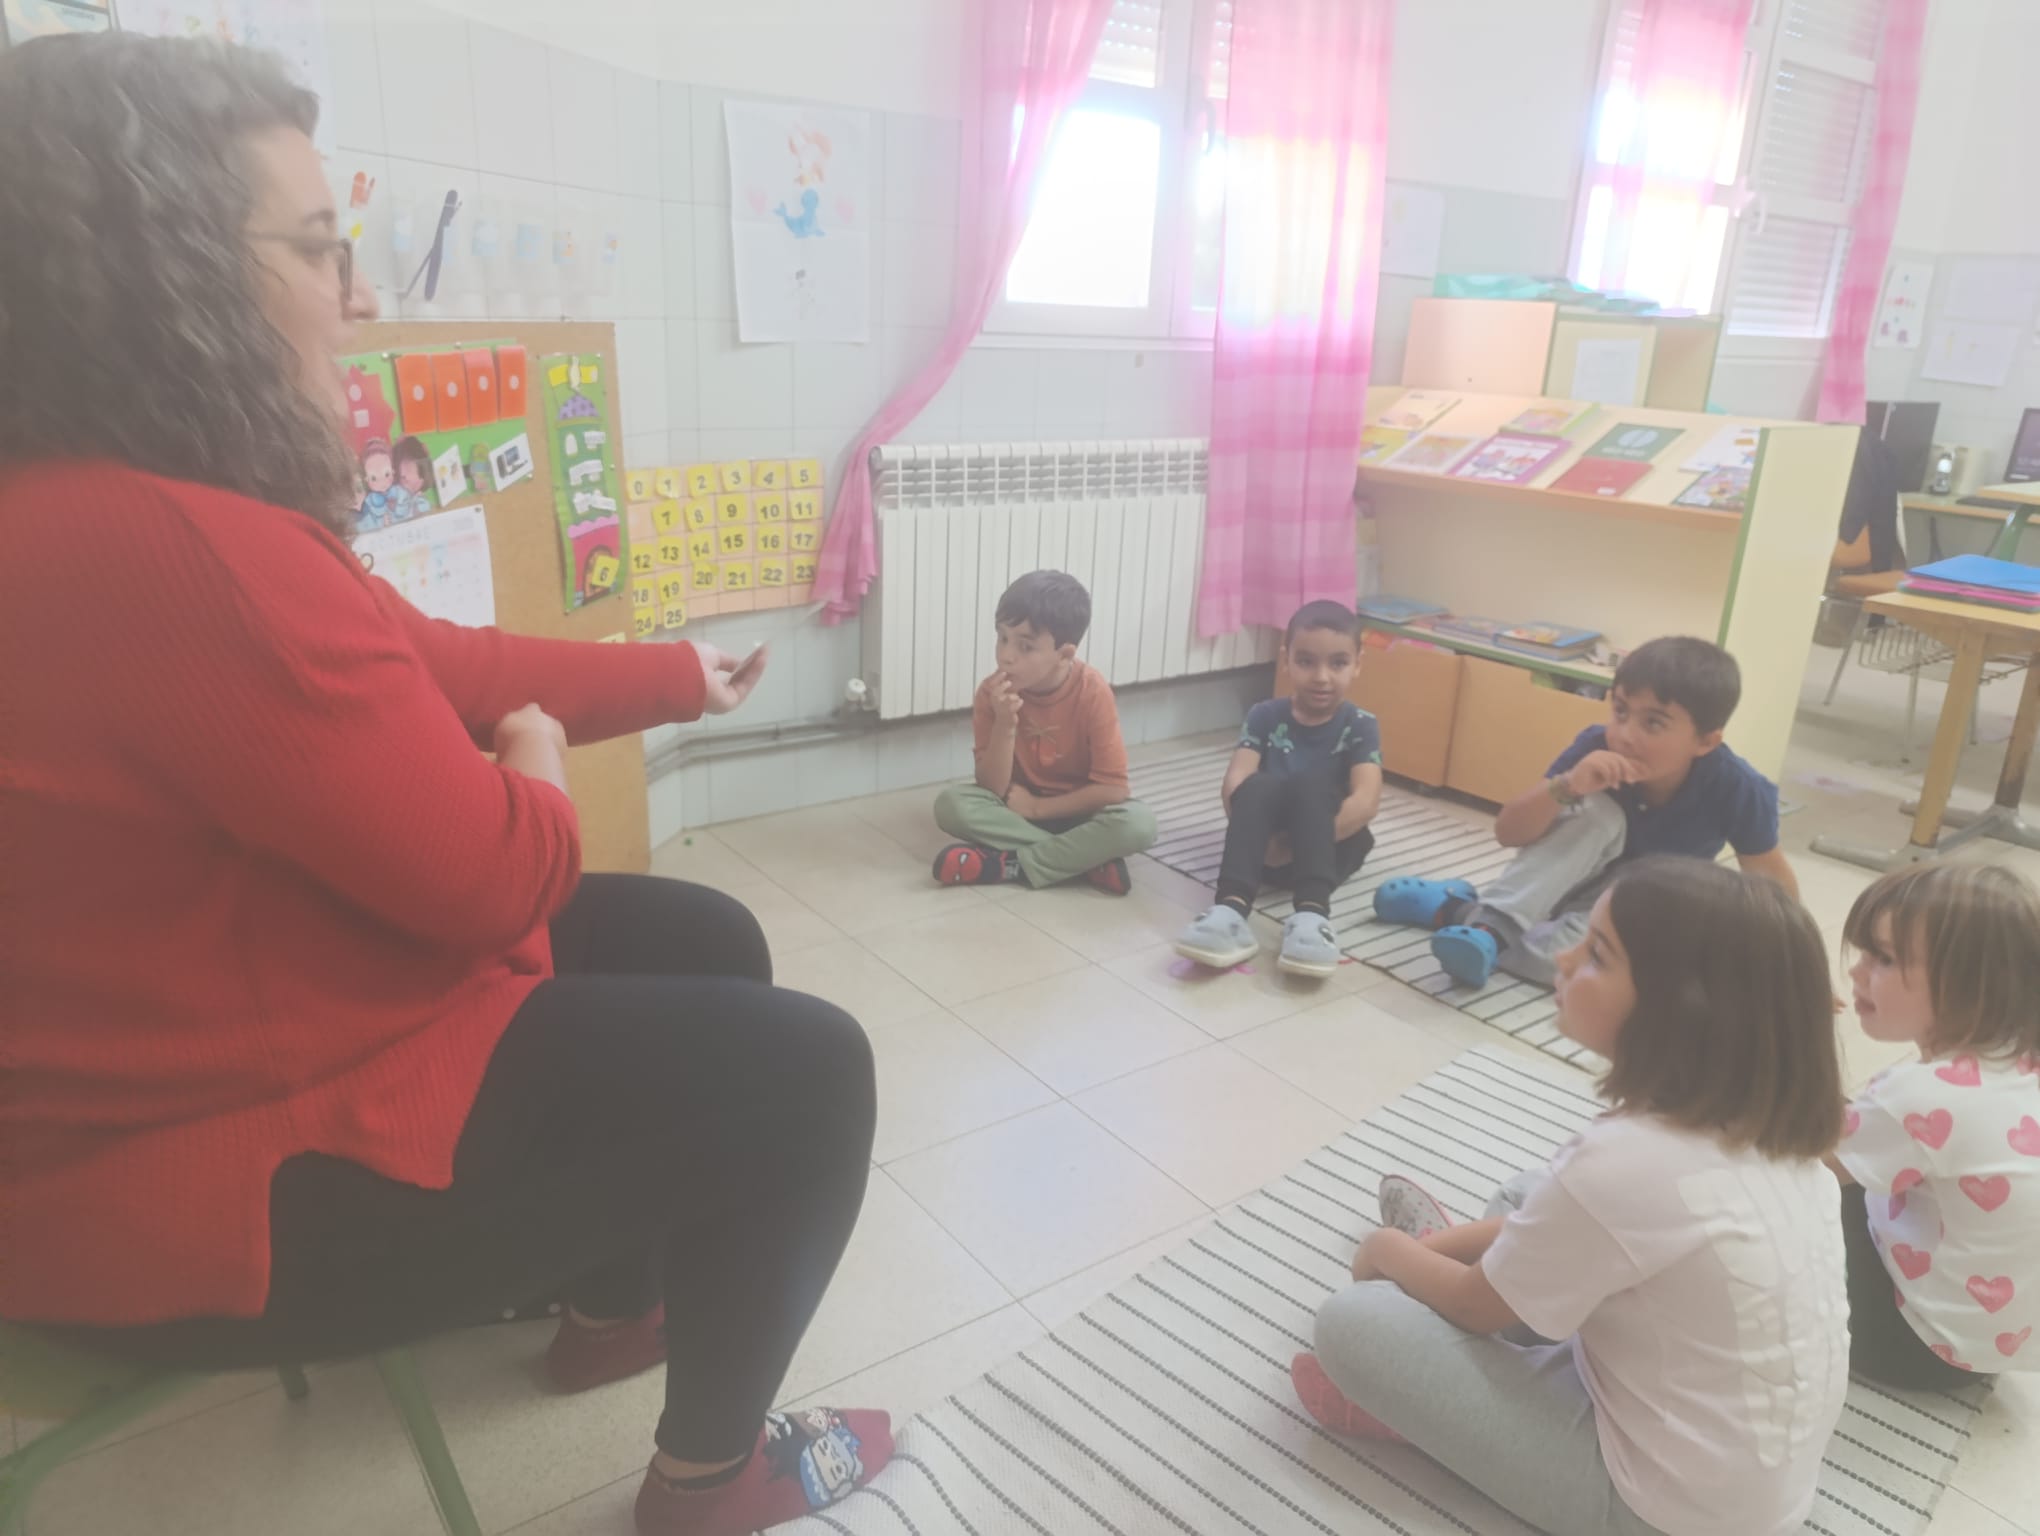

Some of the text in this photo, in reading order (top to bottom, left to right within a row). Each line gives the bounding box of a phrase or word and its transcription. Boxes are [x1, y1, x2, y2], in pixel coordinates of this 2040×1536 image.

[634, 469, 809, 496] 0 1 2 3 4 5
[661, 511, 671, 526] 7
[727, 503, 737, 518] 9
[760, 503, 780, 519] 10
[795, 502, 813, 516] 11
[634, 533, 814, 569] 12 13 14 15 16 17
[599, 566, 609, 582] 6
[633, 588, 649, 602] 18
[662, 581, 680, 598] 19
[695, 571, 713, 585] 20
[728, 571, 747, 586] 21
[762, 567, 783, 582] 22
[636, 608, 683, 632] 24 25
